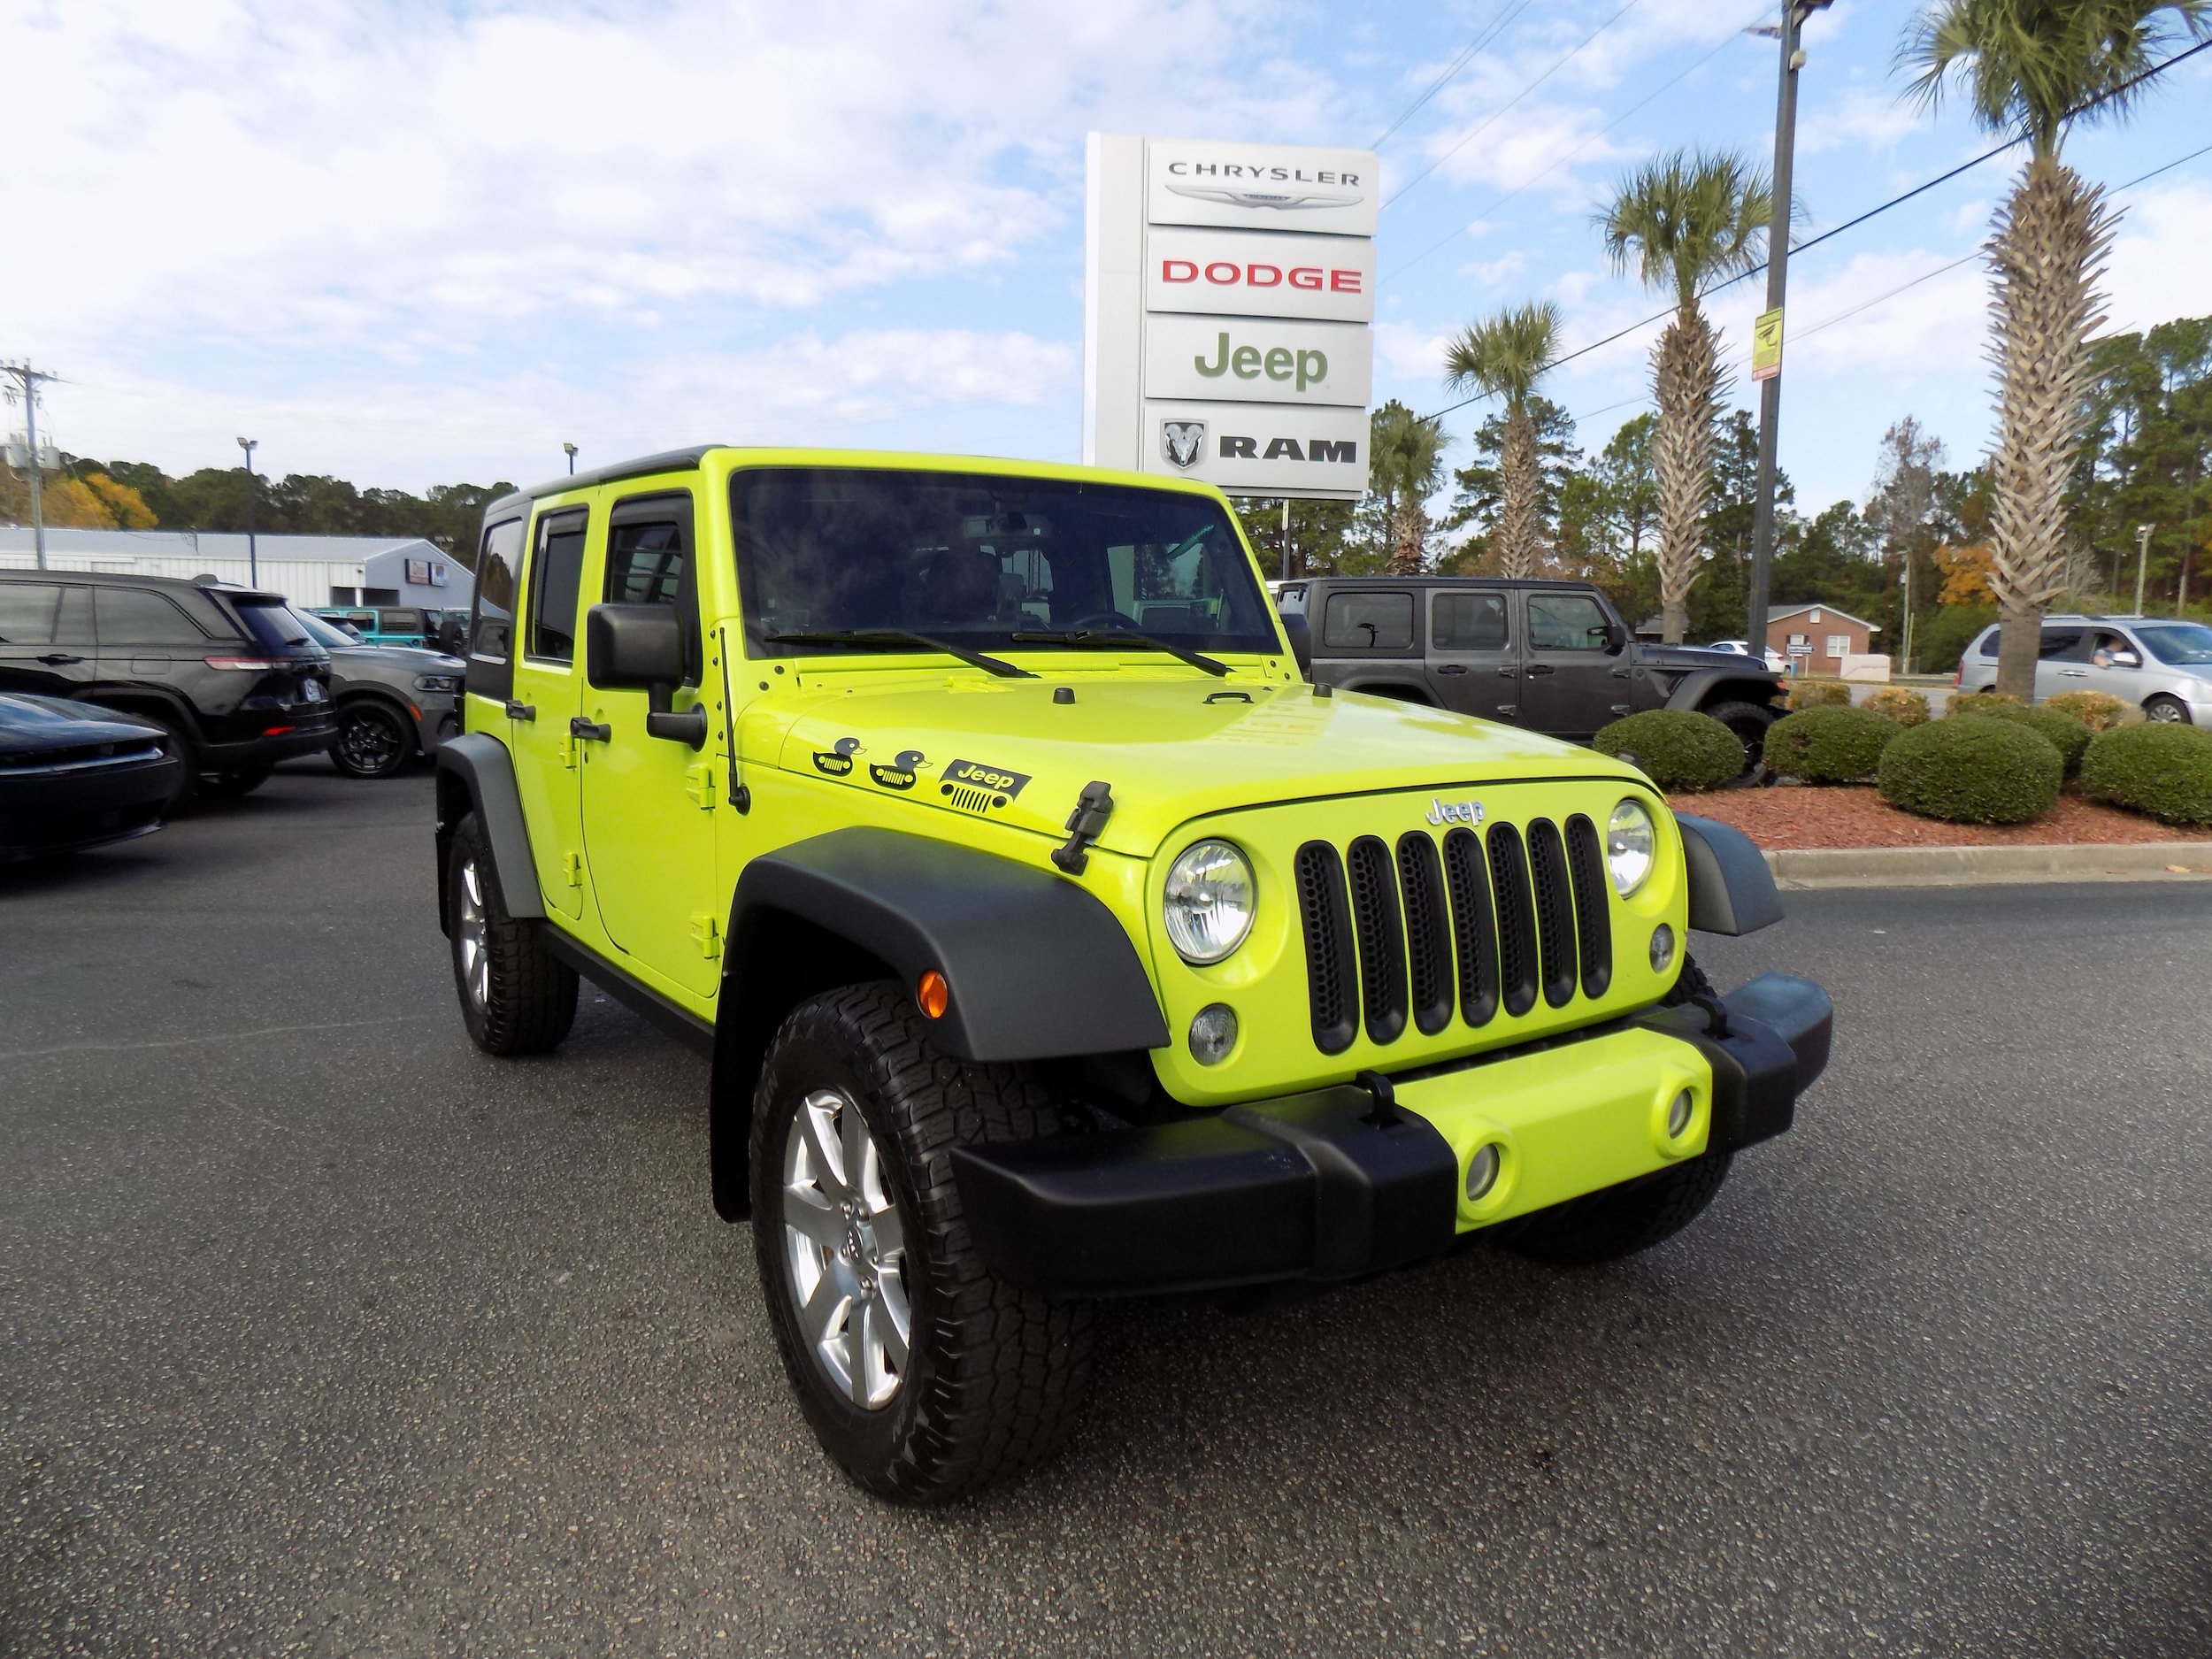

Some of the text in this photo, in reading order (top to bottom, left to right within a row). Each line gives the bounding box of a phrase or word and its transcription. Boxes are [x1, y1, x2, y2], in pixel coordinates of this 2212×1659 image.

[1168, 162, 1360, 187] CHRYSLER
[1162, 260, 1362, 294] DODGE
[1194, 332, 1328, 392] Jeep
[1219, 435, 1357, 464] RAM
[956, 764, 1015, 789] Jeep
[1425, 798, 1486, 826] Jeep
